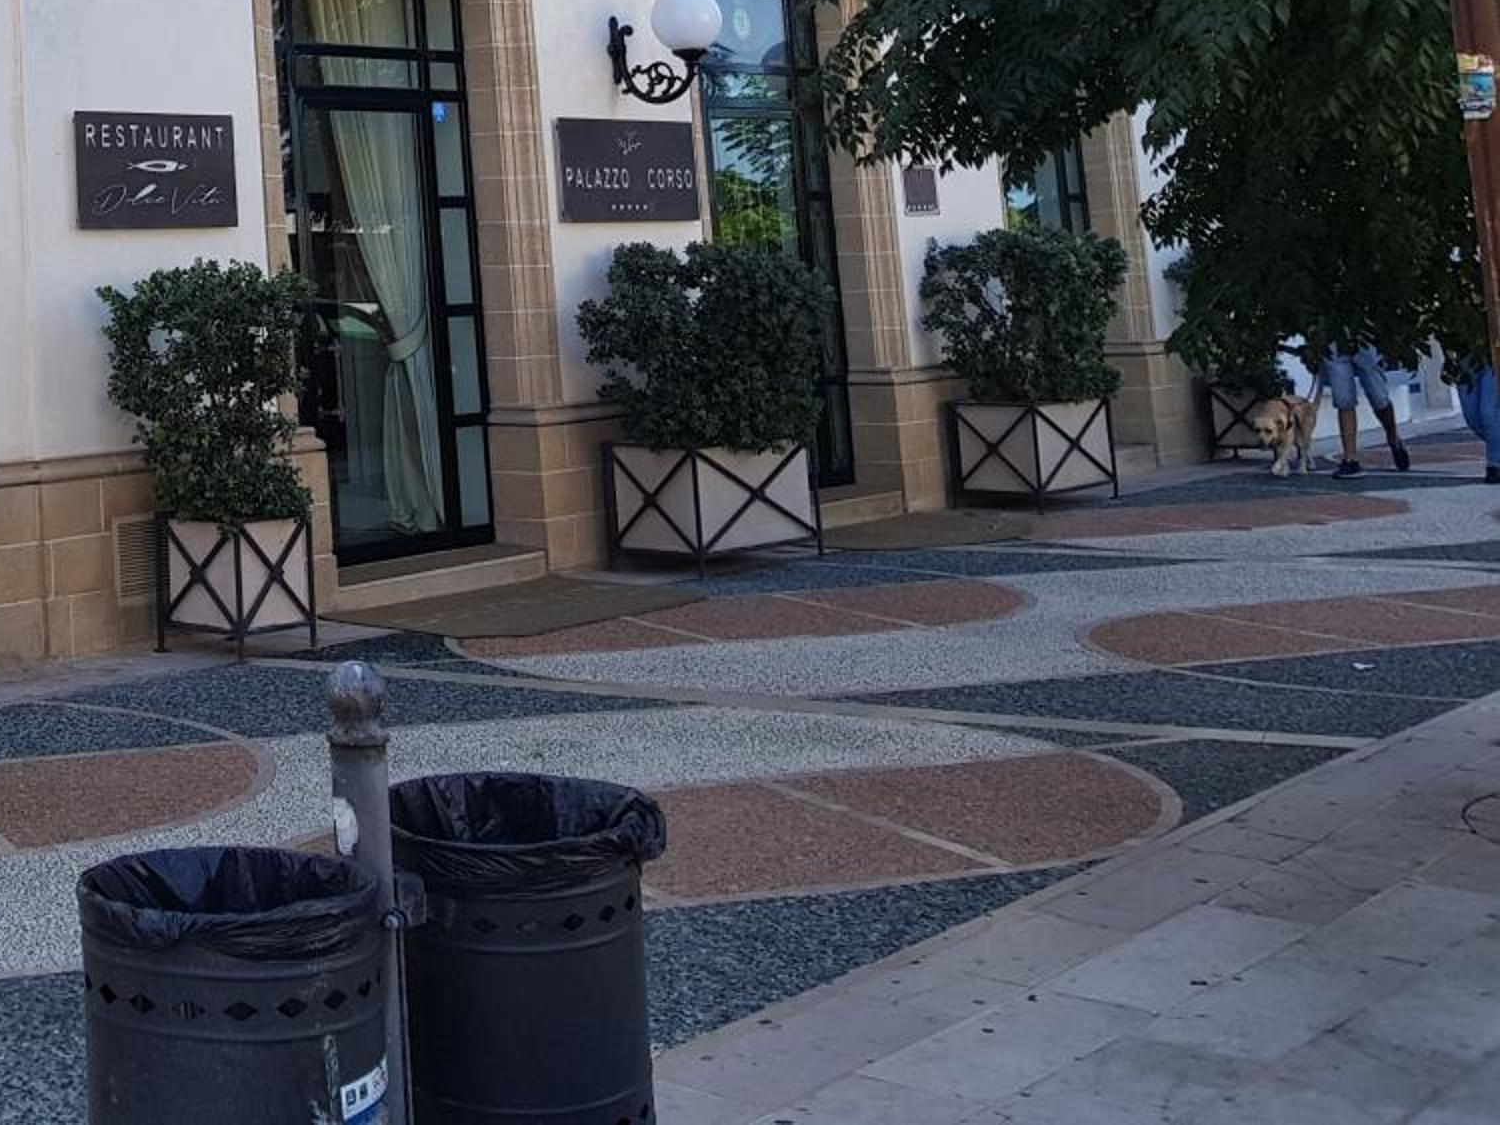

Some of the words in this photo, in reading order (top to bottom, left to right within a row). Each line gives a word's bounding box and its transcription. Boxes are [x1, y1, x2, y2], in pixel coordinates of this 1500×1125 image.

[85, 124, 224, 149] RESTAURANT
[565, 167, 630, 189] PALAZZO
[647, 168, 694, 189] CORSO
